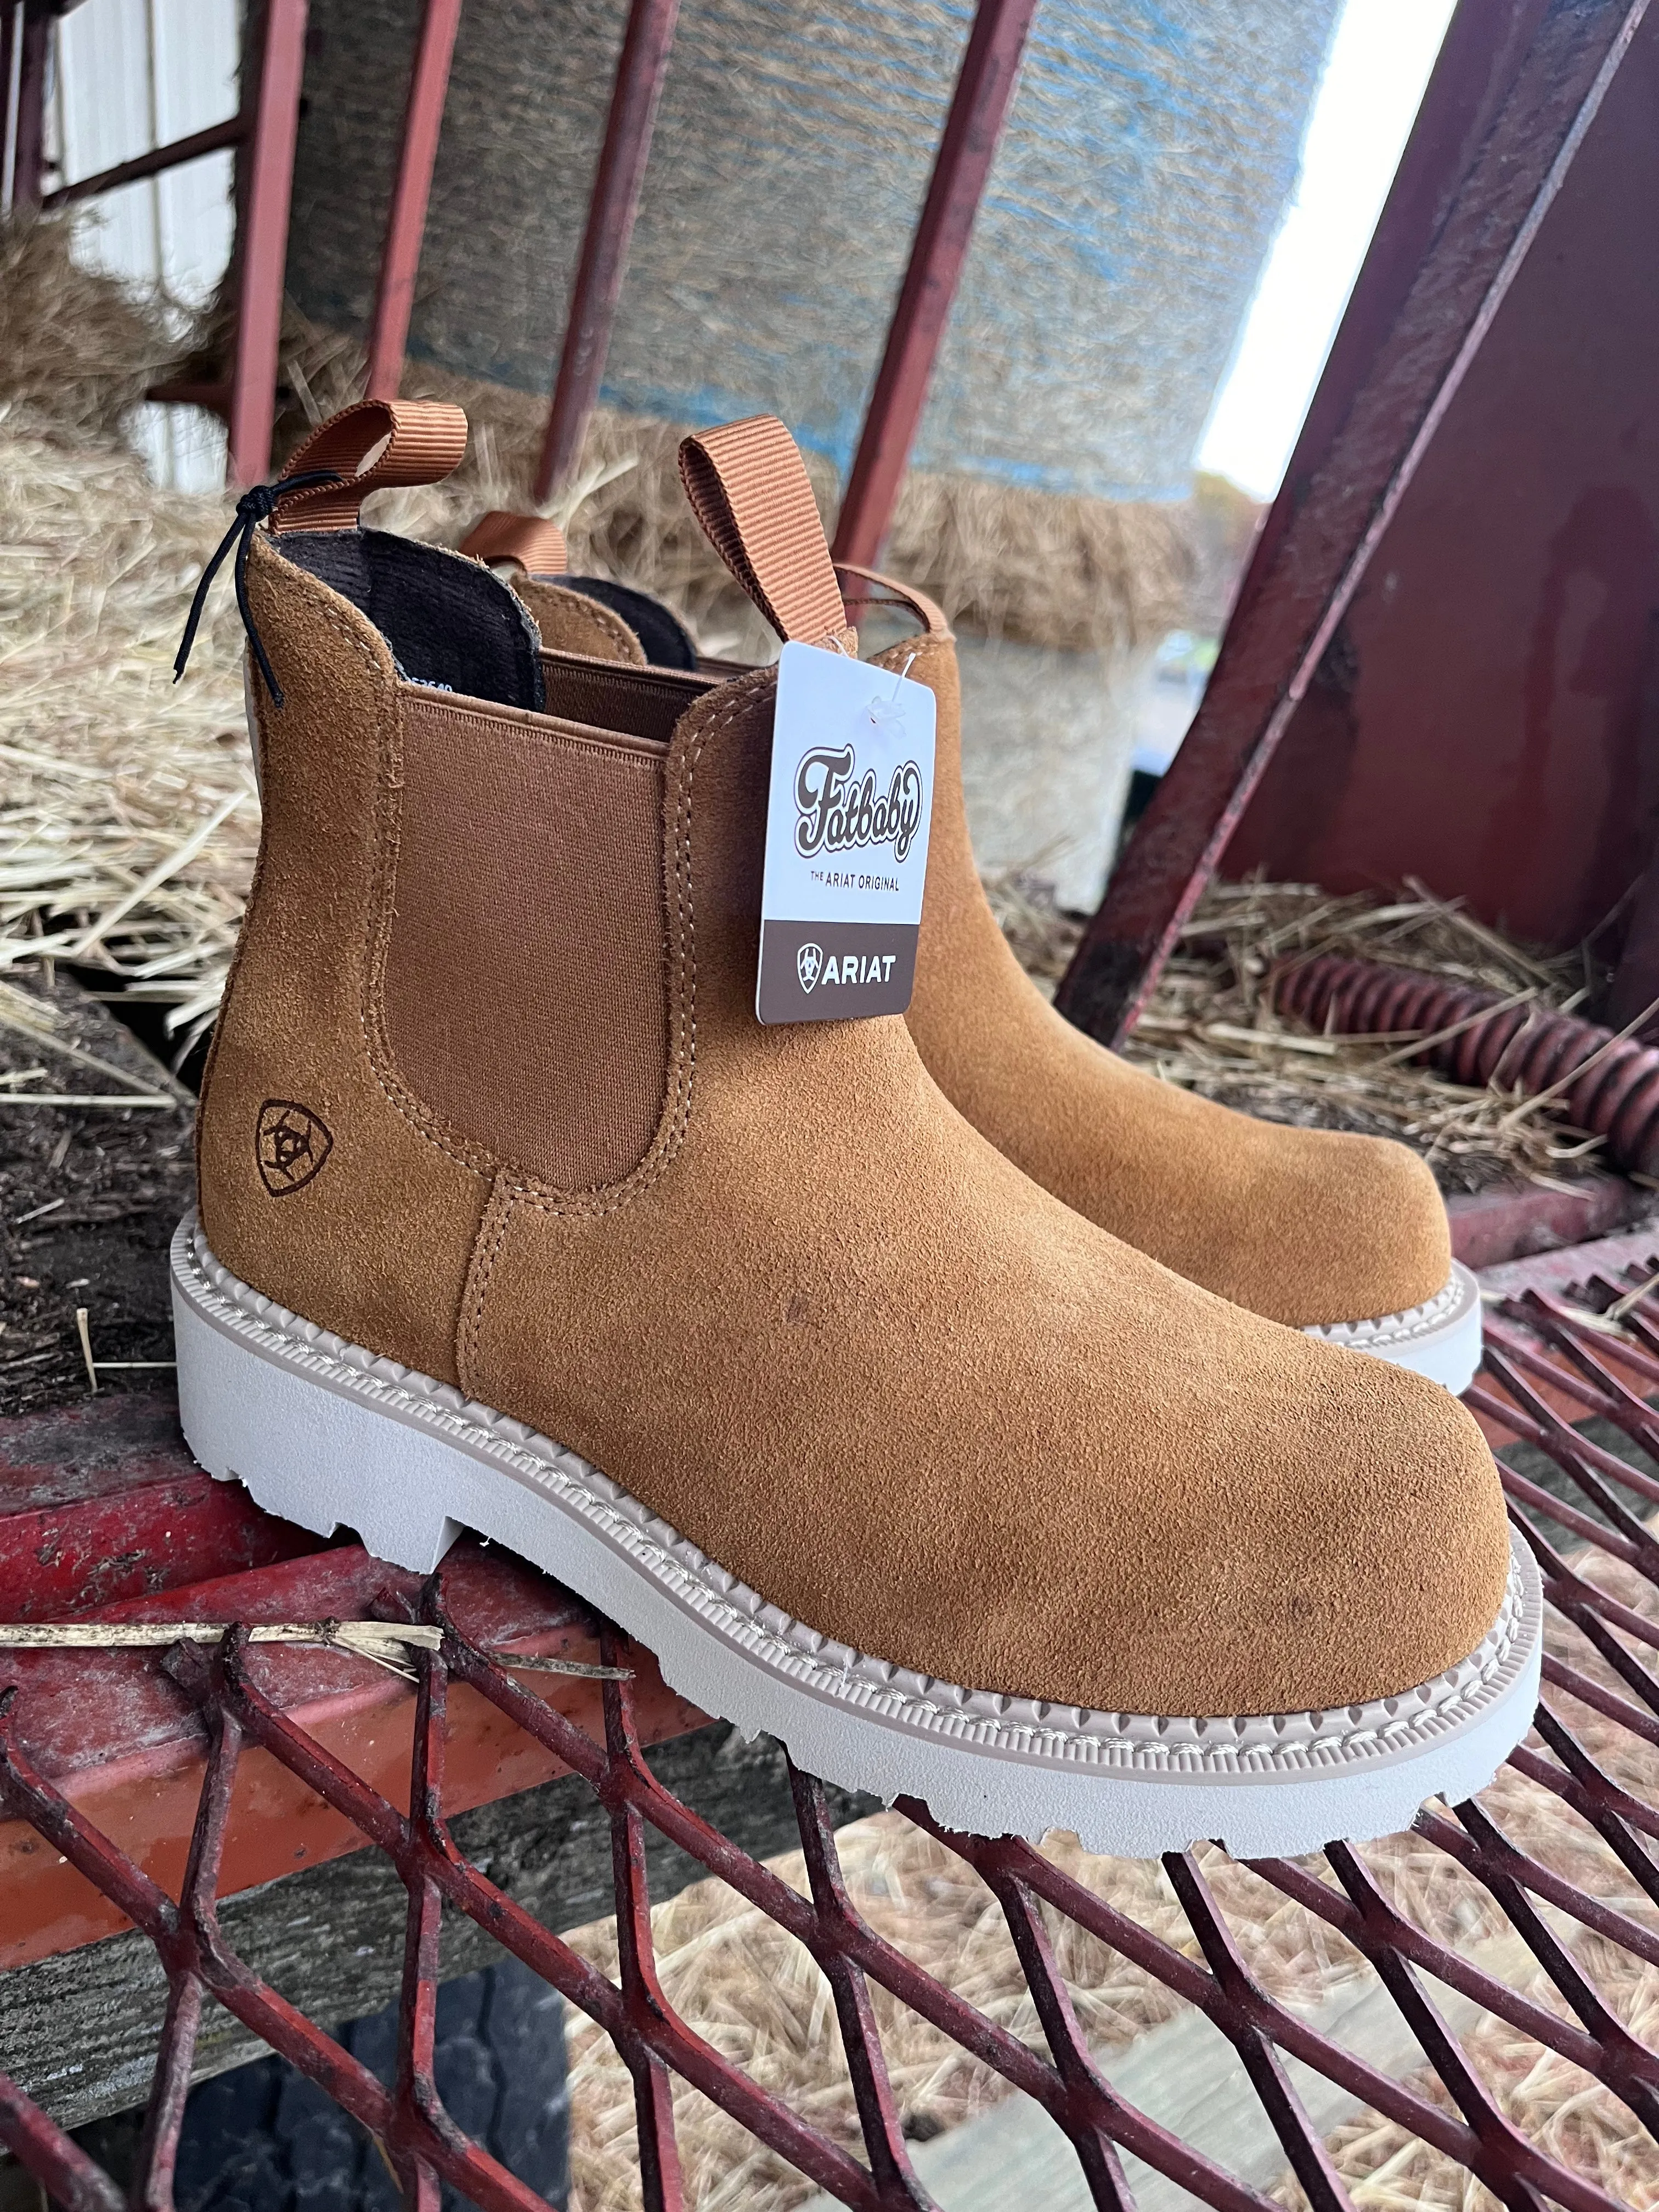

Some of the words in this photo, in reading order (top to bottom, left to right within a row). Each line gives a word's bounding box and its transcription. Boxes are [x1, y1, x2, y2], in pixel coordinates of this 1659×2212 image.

[794, 743, 922, 863] Fatbaby
[811, 871, 823, 881] THE
[826, 872, 855, 889] ARIAT
[859, 874, 899, 891] ORIGINAL
[821, 955, 896, 985] ARIAT
